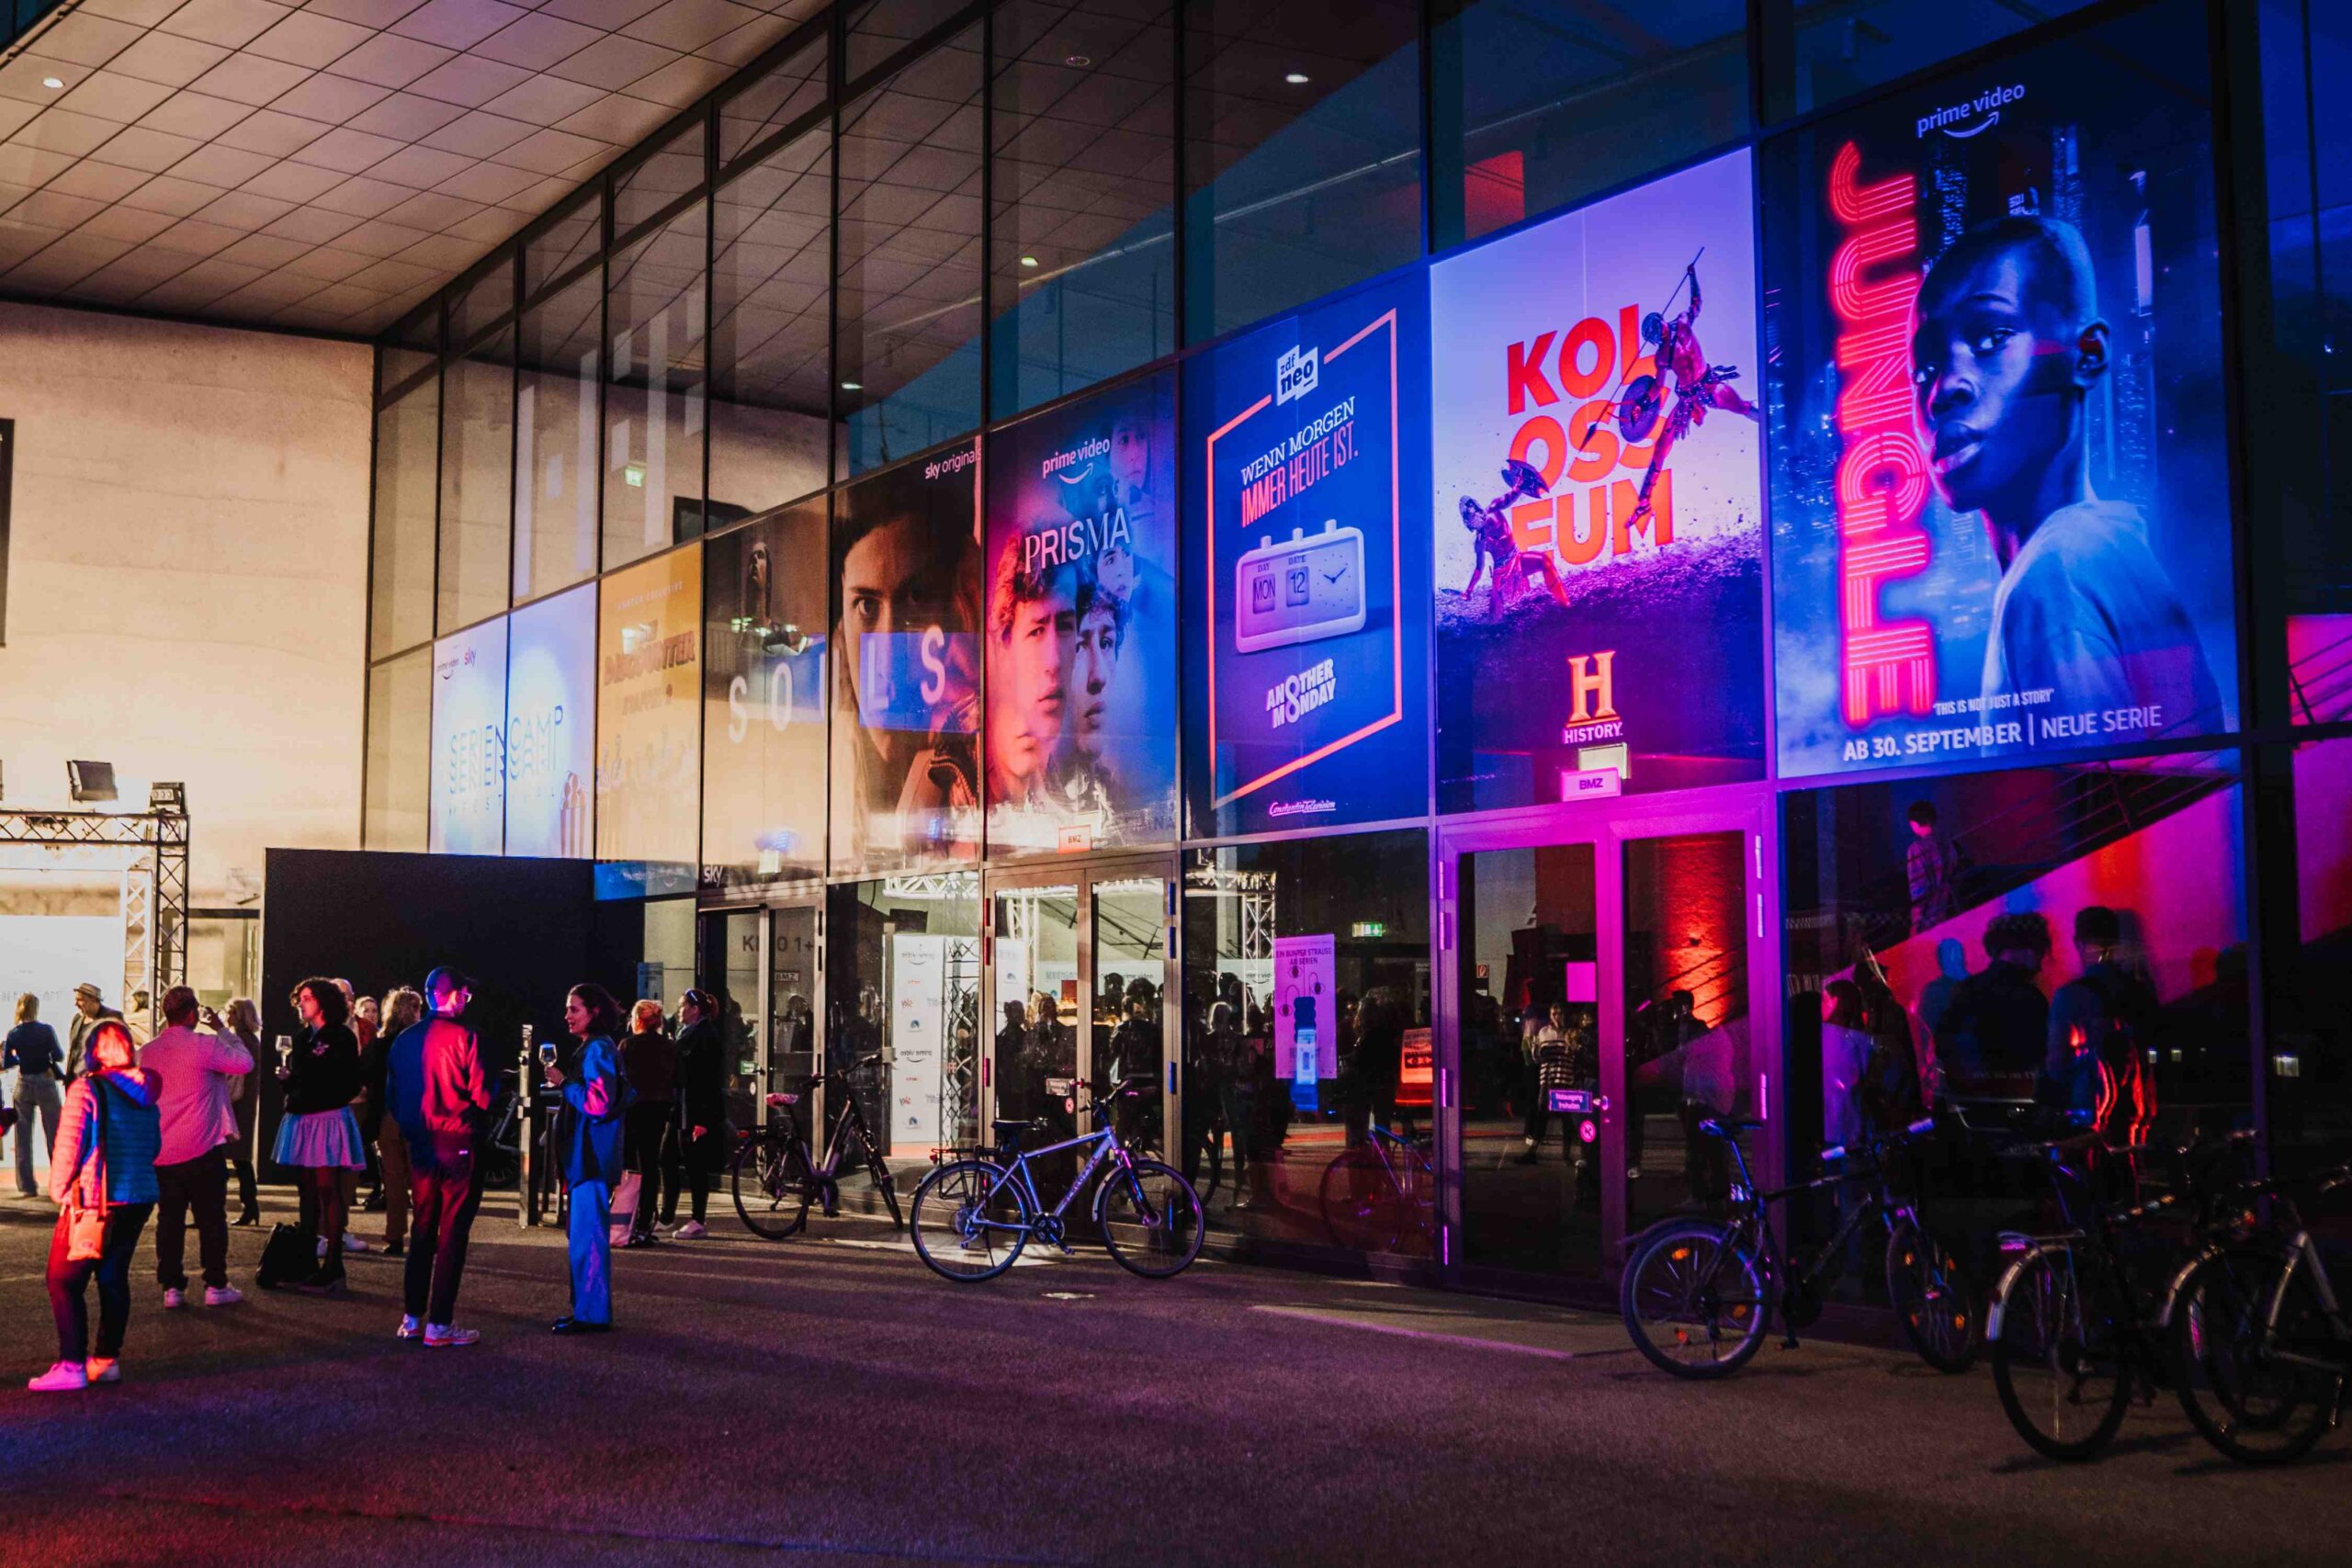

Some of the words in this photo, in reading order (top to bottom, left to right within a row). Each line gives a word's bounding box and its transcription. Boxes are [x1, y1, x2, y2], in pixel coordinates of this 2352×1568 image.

[1917, 103, 1971, 138] prime
[1973, 84, 2025, 112] video
[1280, 353, 1296, 375] zdf
[1280, 359, 1315, 396] neo
[1507, 303, 1657, 416] KOL
[1240, 442, 1286, 486] WENN
[1288, 396, 1356, 457] MORGEN
[1830, 140, 1931, 725] JUNGLE
[924, 462, 941, 479] sky
[1042, 451, 1076, 479] prime
[1077, 437, 1111, 460] video
[1241, 466, 1286, 528] IMMER
[1288, 435, 1330, 498] HEUTE
[1333, 421, 1359, 470] IST.
[1511, 468, 1674, 566] EUM
[1024, 508, 1131, 574] PRISMA
[1257, 562, 1271, 573] DAY
[1287, 554, 1306, 566] DATE
[1253, 579, 1275, 603] MON
[1290, 571, 1306, 594] 12
[464, 647, 477, 667] sky
[1567, 650, 1616, 723] H
[1957, 699, 1967, 713] IS
[1968, 697, 1985, 712] NOT
[2012, 693, 2020, 706] A
[1843, 739, 1870, 762] AB
[1872, 738, 1902, 760] 30.
[1905, 722, 2022, 752] SEPTEMBER
[2041, 713, 2098, 740] NEUE
[2103, 705, 2163, 732] SERIE
[1578, 778, 1604, 790] BMZ
[1068, 834, 1081, 844] BMZ
[704, 864, 724, 887] sky
[742, 935, 788, 953] KIO
